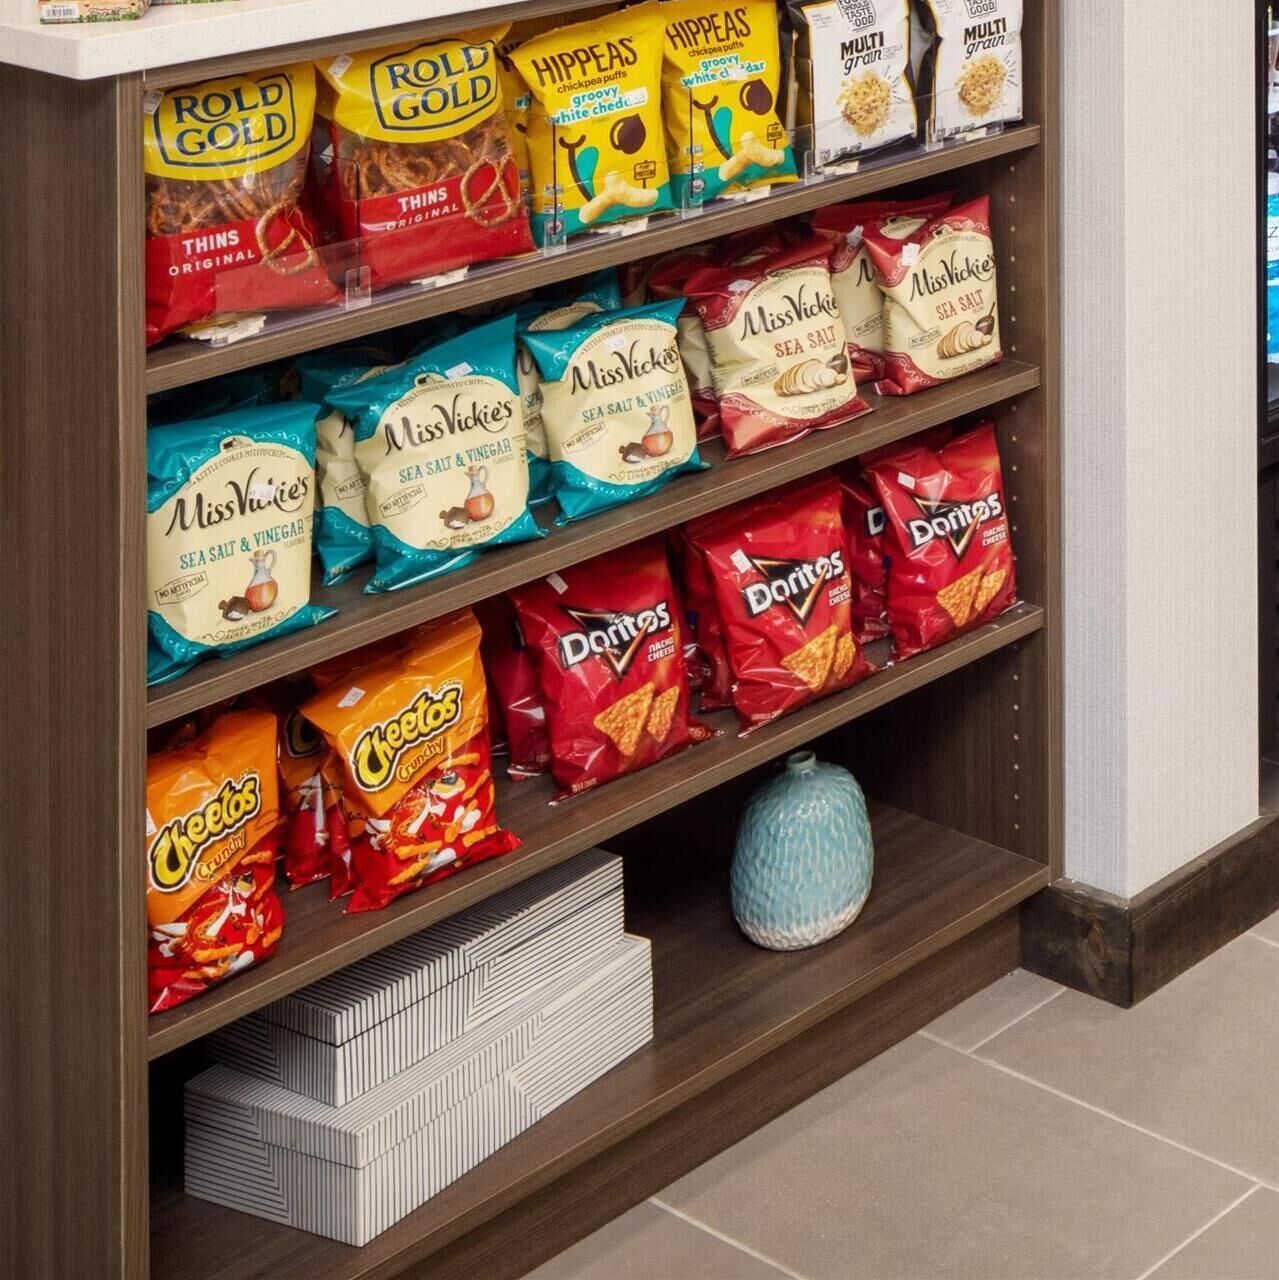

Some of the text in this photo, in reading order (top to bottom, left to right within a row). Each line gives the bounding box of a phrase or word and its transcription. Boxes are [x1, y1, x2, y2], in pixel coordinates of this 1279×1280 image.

[665, 7, 751, 51] HIPPEAS
[963, 17, 1007, 45] MULTI
[531, 37, 638, 86] HIPPEAS
[688, 39, 744, 58] chickpea puffs
[700, 54, 740, 71] groovy
[840, 31, 884, 61] MULTI
[843, 47, 882, 76] grain
[965, 34, 1005, 59] grain
[385, 44, 490, 90] ROLD
[557, 70, 628, 94] chickpea puffs
[682, 71, 717, 88] white
[172, 83, 284, 124] ROLD
[392, 74, 493, 121] GOLD
[572, 85, 618, 107] groovy
[176, 113, 287, 157] GOLD
[398, 186, 448, 212] THINS
[385, 203, 460, 231] ORIGINAL
[182, 230, 240, 256] THINS
[168, 249, 256, 276] ORIGINAL
[935, 289, 985, 322] SEA SALT
[774, 325, 836, 359] SEA SALT
[581, 378, 684, 424] SEA SALT & VINEGAR
[398, 438, 512, 484] SEA SALT & VINEGAR
[910, 492, 1002, 548] Doritos
[982, 524, 1005, 539] NACHO
[179, 518, 305, 571] SEA SALT & VINEGAR
[982, 531, 1007, 548] CHEESE
[746, 549, 845, 616] Doritos
[562, 600, 671, 668] Doritos
[648, 636, 675, 653] NACHO
[647, 646, 676, 664] CHEESE
[352, 685, 463, 792] Cheetos
[398, 736, 444, 783] Crunchy
[151, 773, 262, 891] Cheetos
[196, 828, 246, 881] Crunchy
